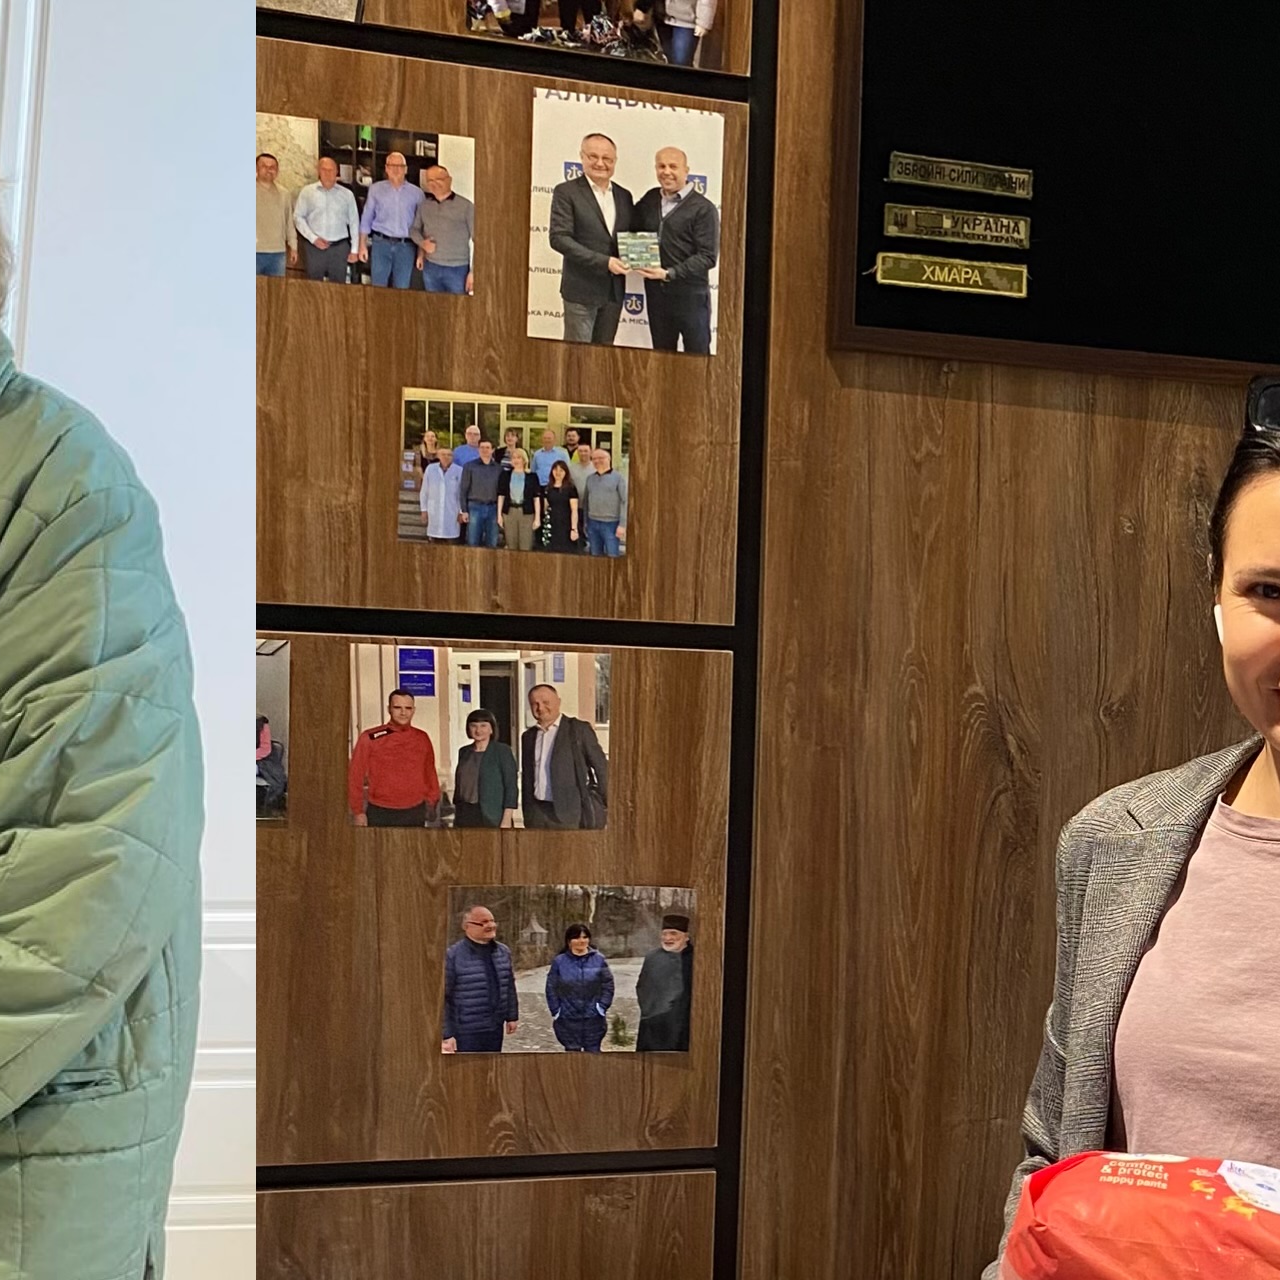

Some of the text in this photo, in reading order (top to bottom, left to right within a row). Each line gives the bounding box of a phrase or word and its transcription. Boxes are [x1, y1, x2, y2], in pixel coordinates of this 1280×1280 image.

[951, 213, 1021, 235] УКРАЇНА
[922, 264, 983, 286] ХМАРА
[1109, 1160, 1164, 1172] comfort
[1118, 1166, 1169, 1180] protect
[1099, 1175, 1168, 1190] nappy pants
